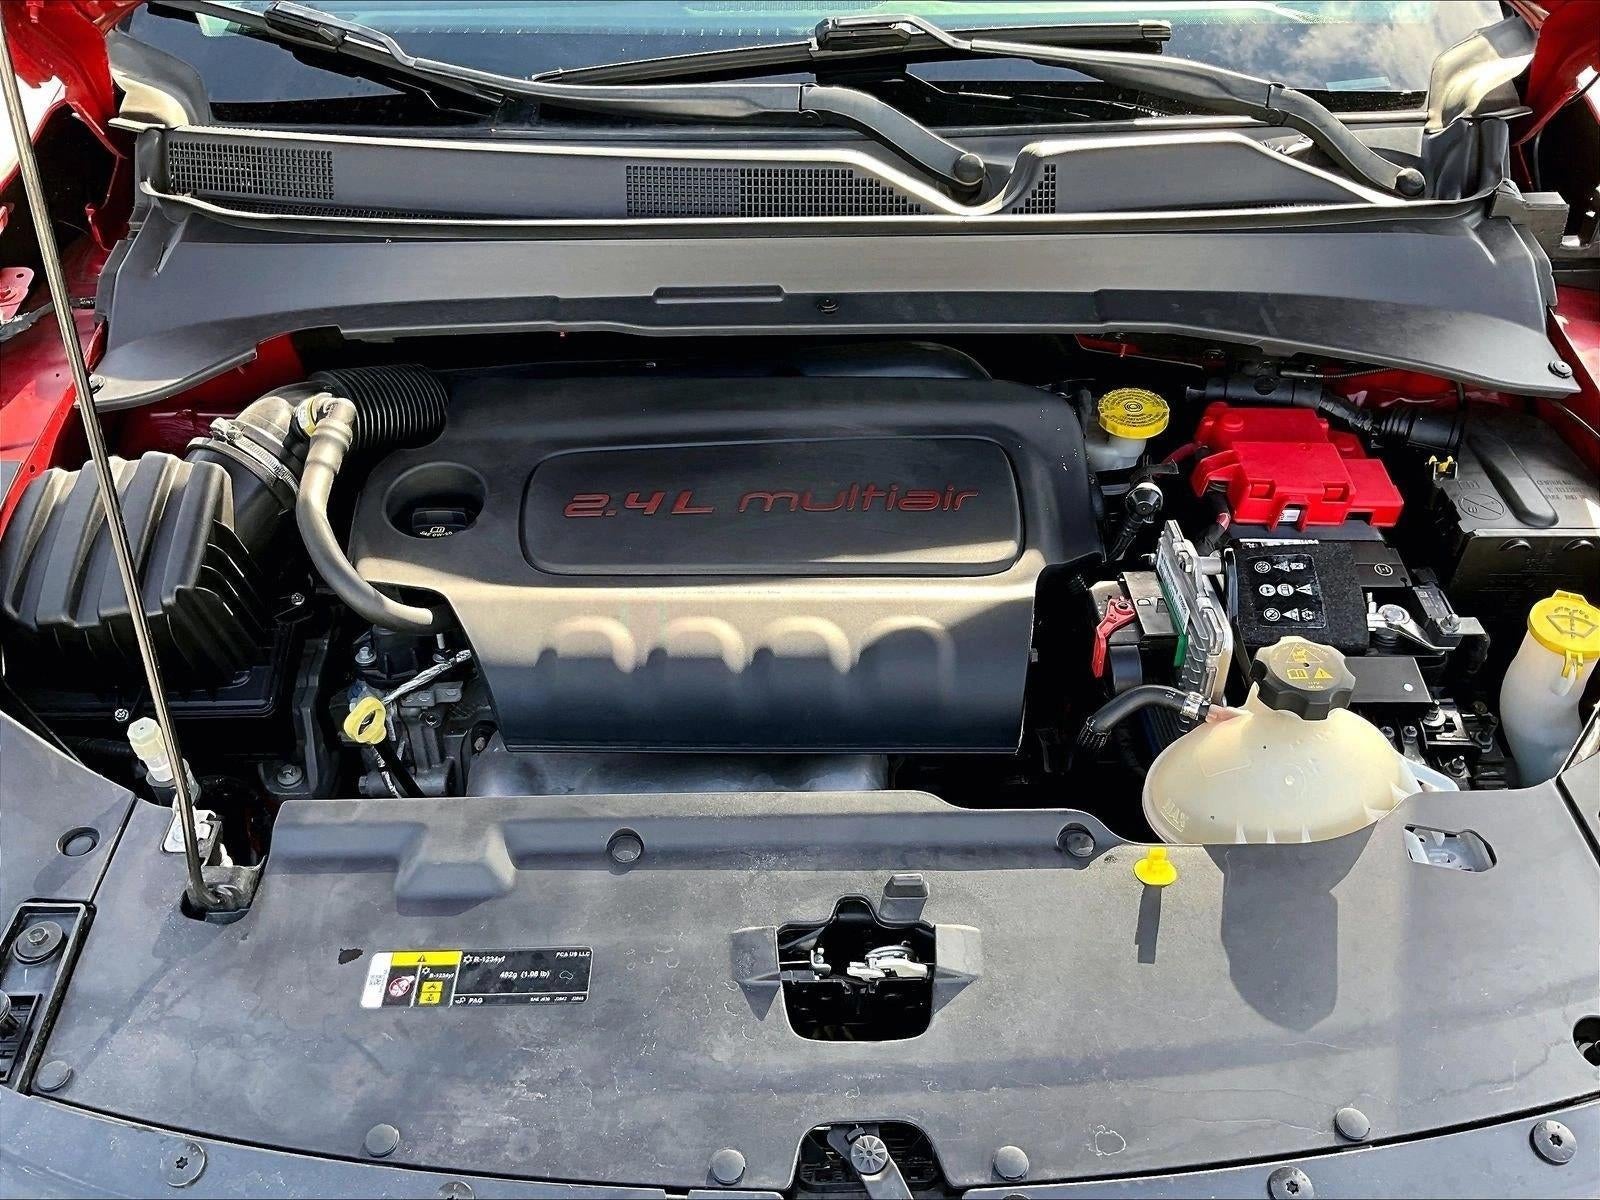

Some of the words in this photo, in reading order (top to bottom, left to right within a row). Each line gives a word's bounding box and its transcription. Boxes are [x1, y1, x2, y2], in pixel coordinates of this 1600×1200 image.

[563, 489, 715, 517] 2.4L
[737, 483, 979, 513] multiair
[473, 955, 506, 964] R-1234yf
